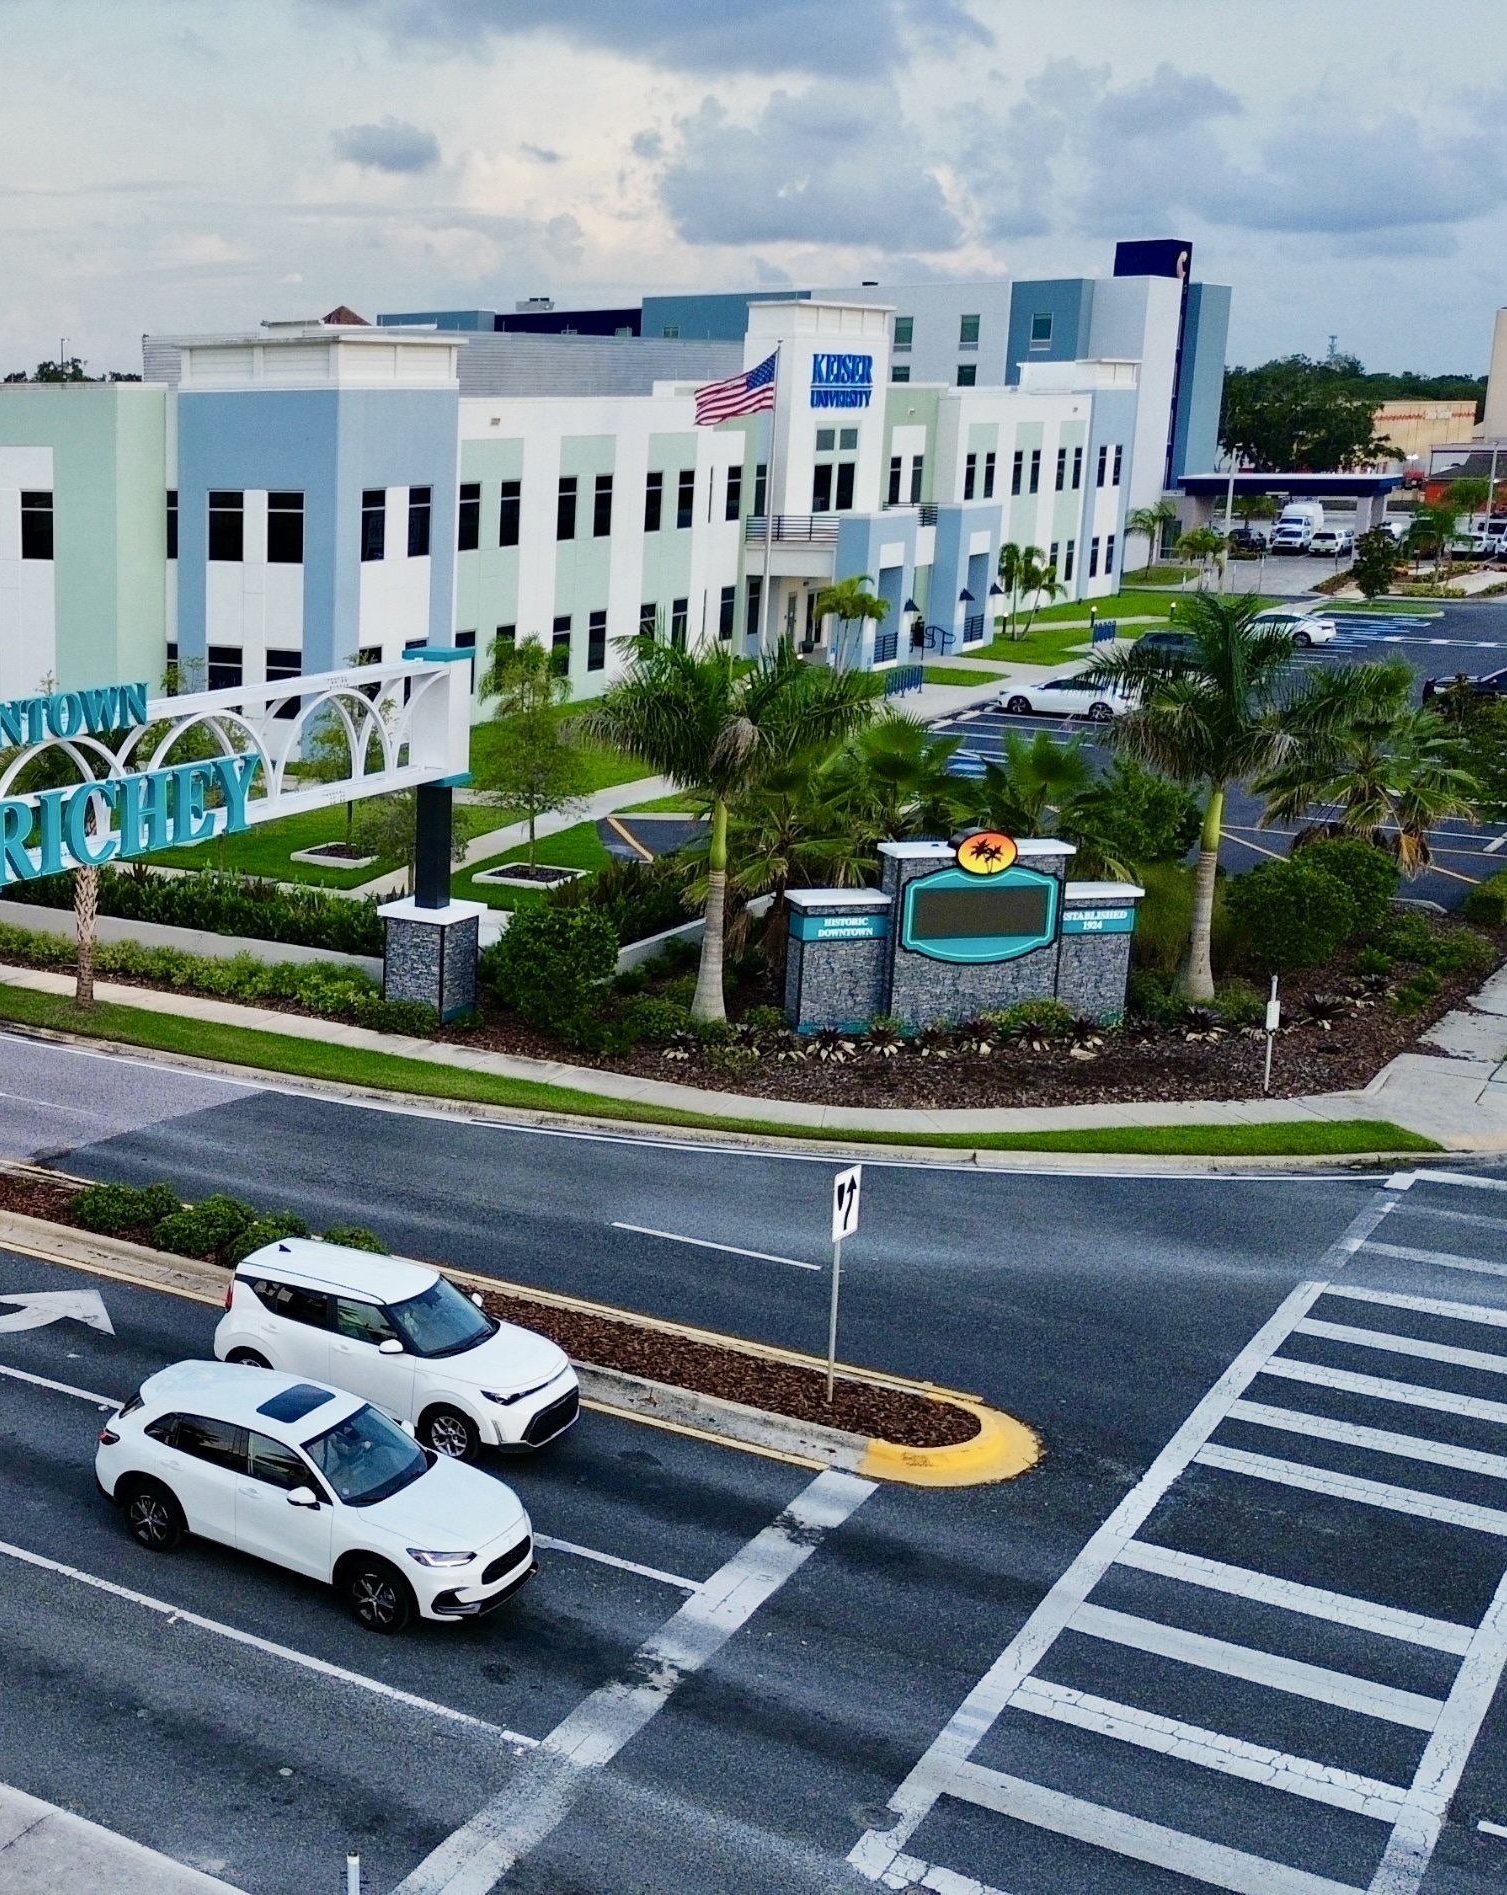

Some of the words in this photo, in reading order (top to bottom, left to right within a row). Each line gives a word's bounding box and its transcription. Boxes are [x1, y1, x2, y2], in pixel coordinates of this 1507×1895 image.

[811, 354, 872, 383] KEISER
[810, 389, 872, 408] UNIVERSITY
[824, 918, 869, 927] HISTORIC
[1083, 920, 1103, 930] 1924
[817, 927, 873, 937] DOWNTOWN
